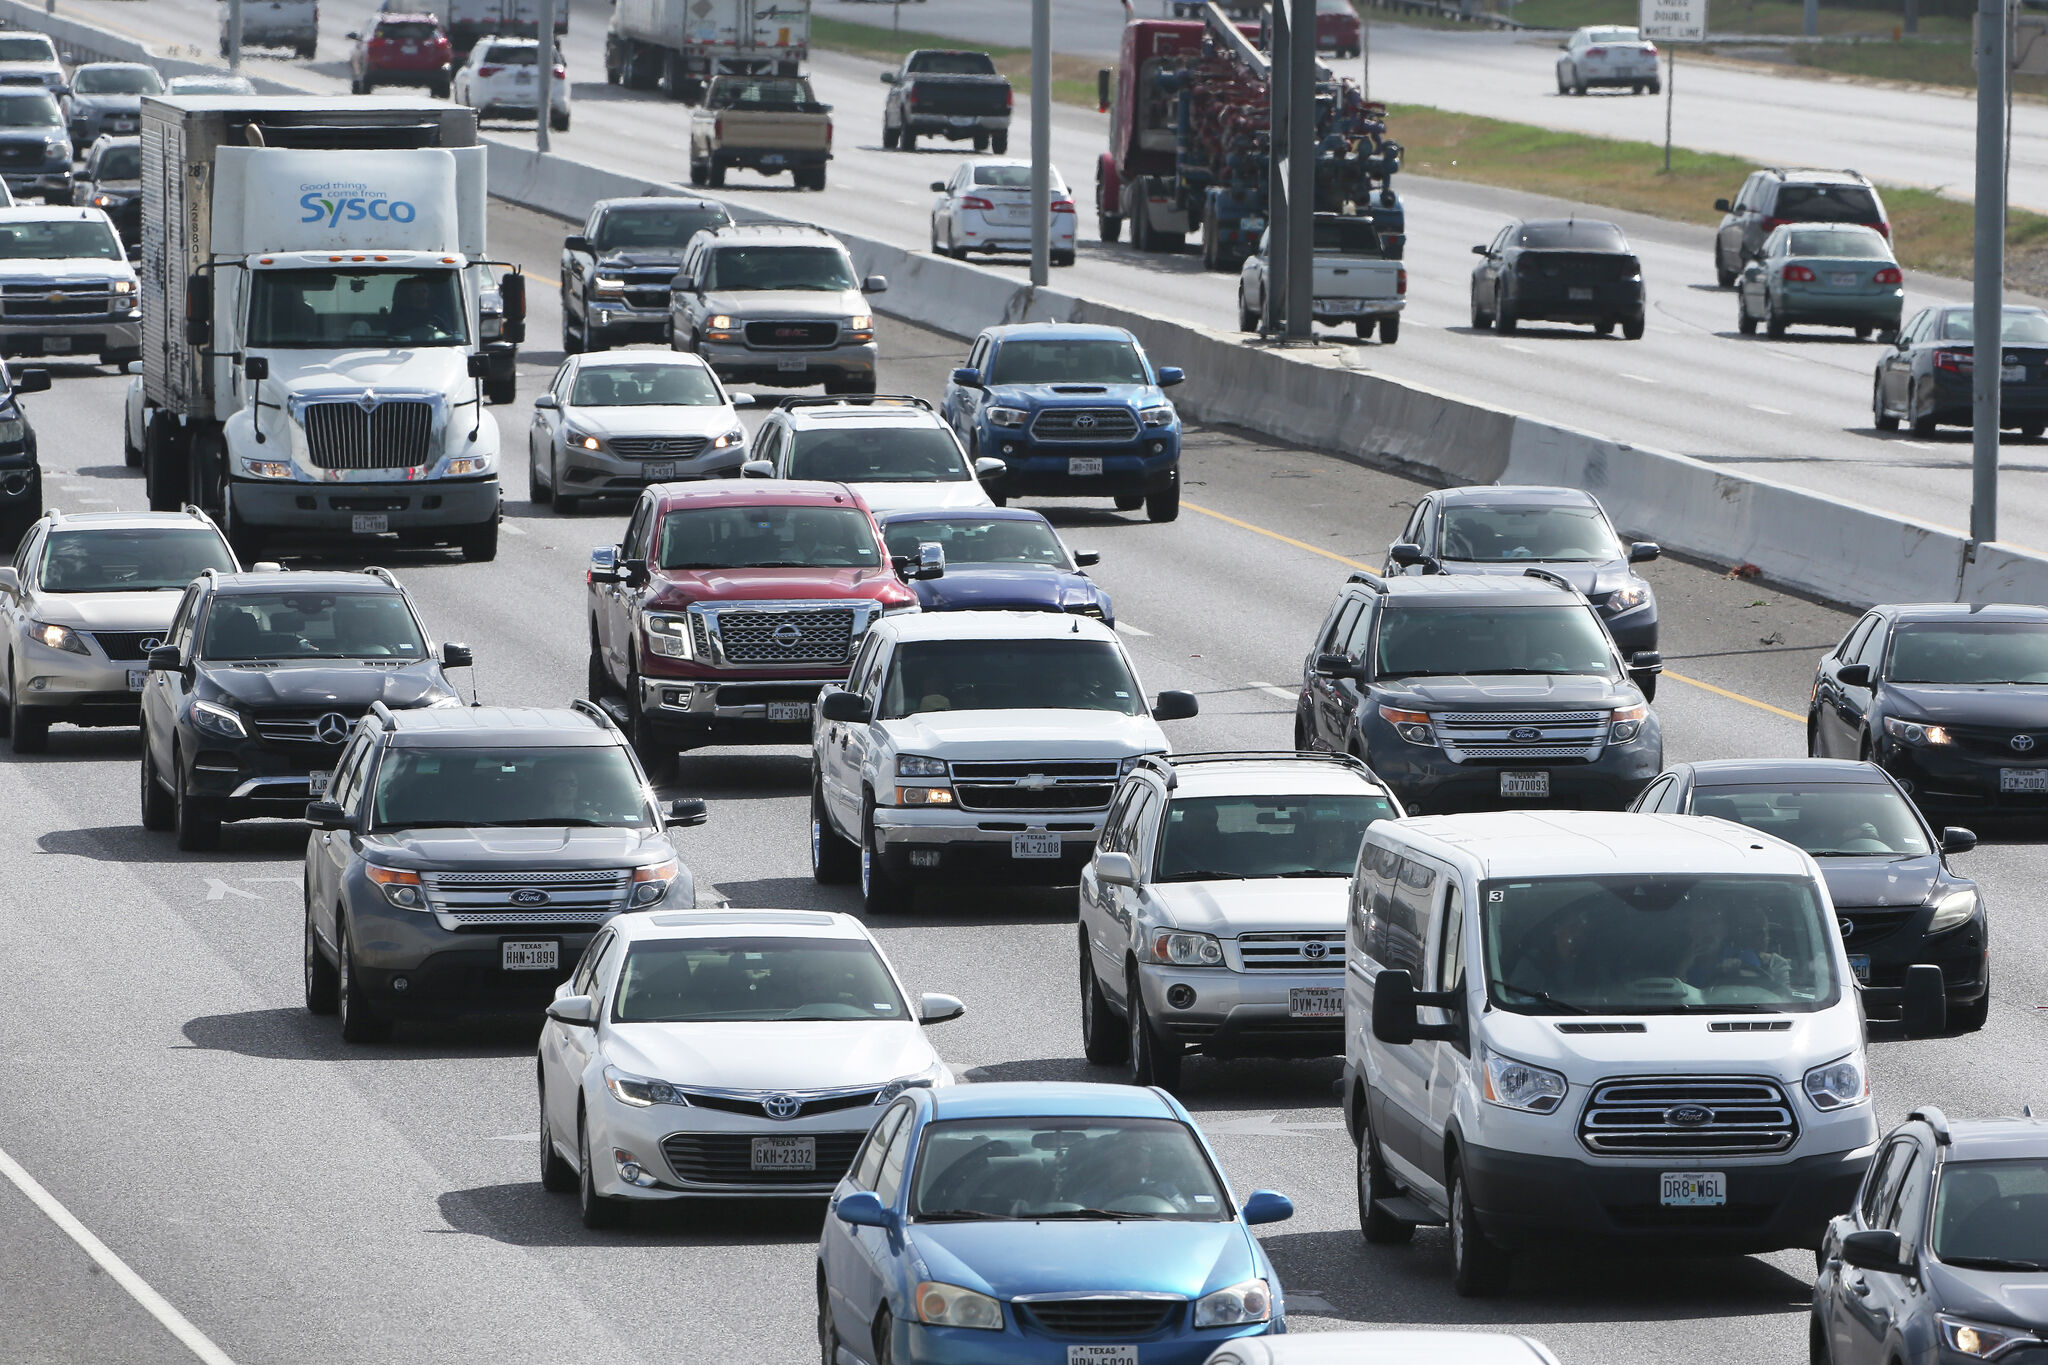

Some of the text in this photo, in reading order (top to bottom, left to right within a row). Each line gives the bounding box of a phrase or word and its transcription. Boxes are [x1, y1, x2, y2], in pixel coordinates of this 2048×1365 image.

[1654, 10, 1691, 22] DOUBLE
[1645, 25, 1701, 38] WHITE LINE
[300, 181, 368, 192] Good things
[327, 190, 387, 198] come from
[300, 192, 416, 229] Sysco
[1515, 729, 1535, 738] Ford
[518, 891, 541, 902] Ford
[1491, 891, 1502, 901] 3
[1676, 1109, 1704, 1121] Ford
